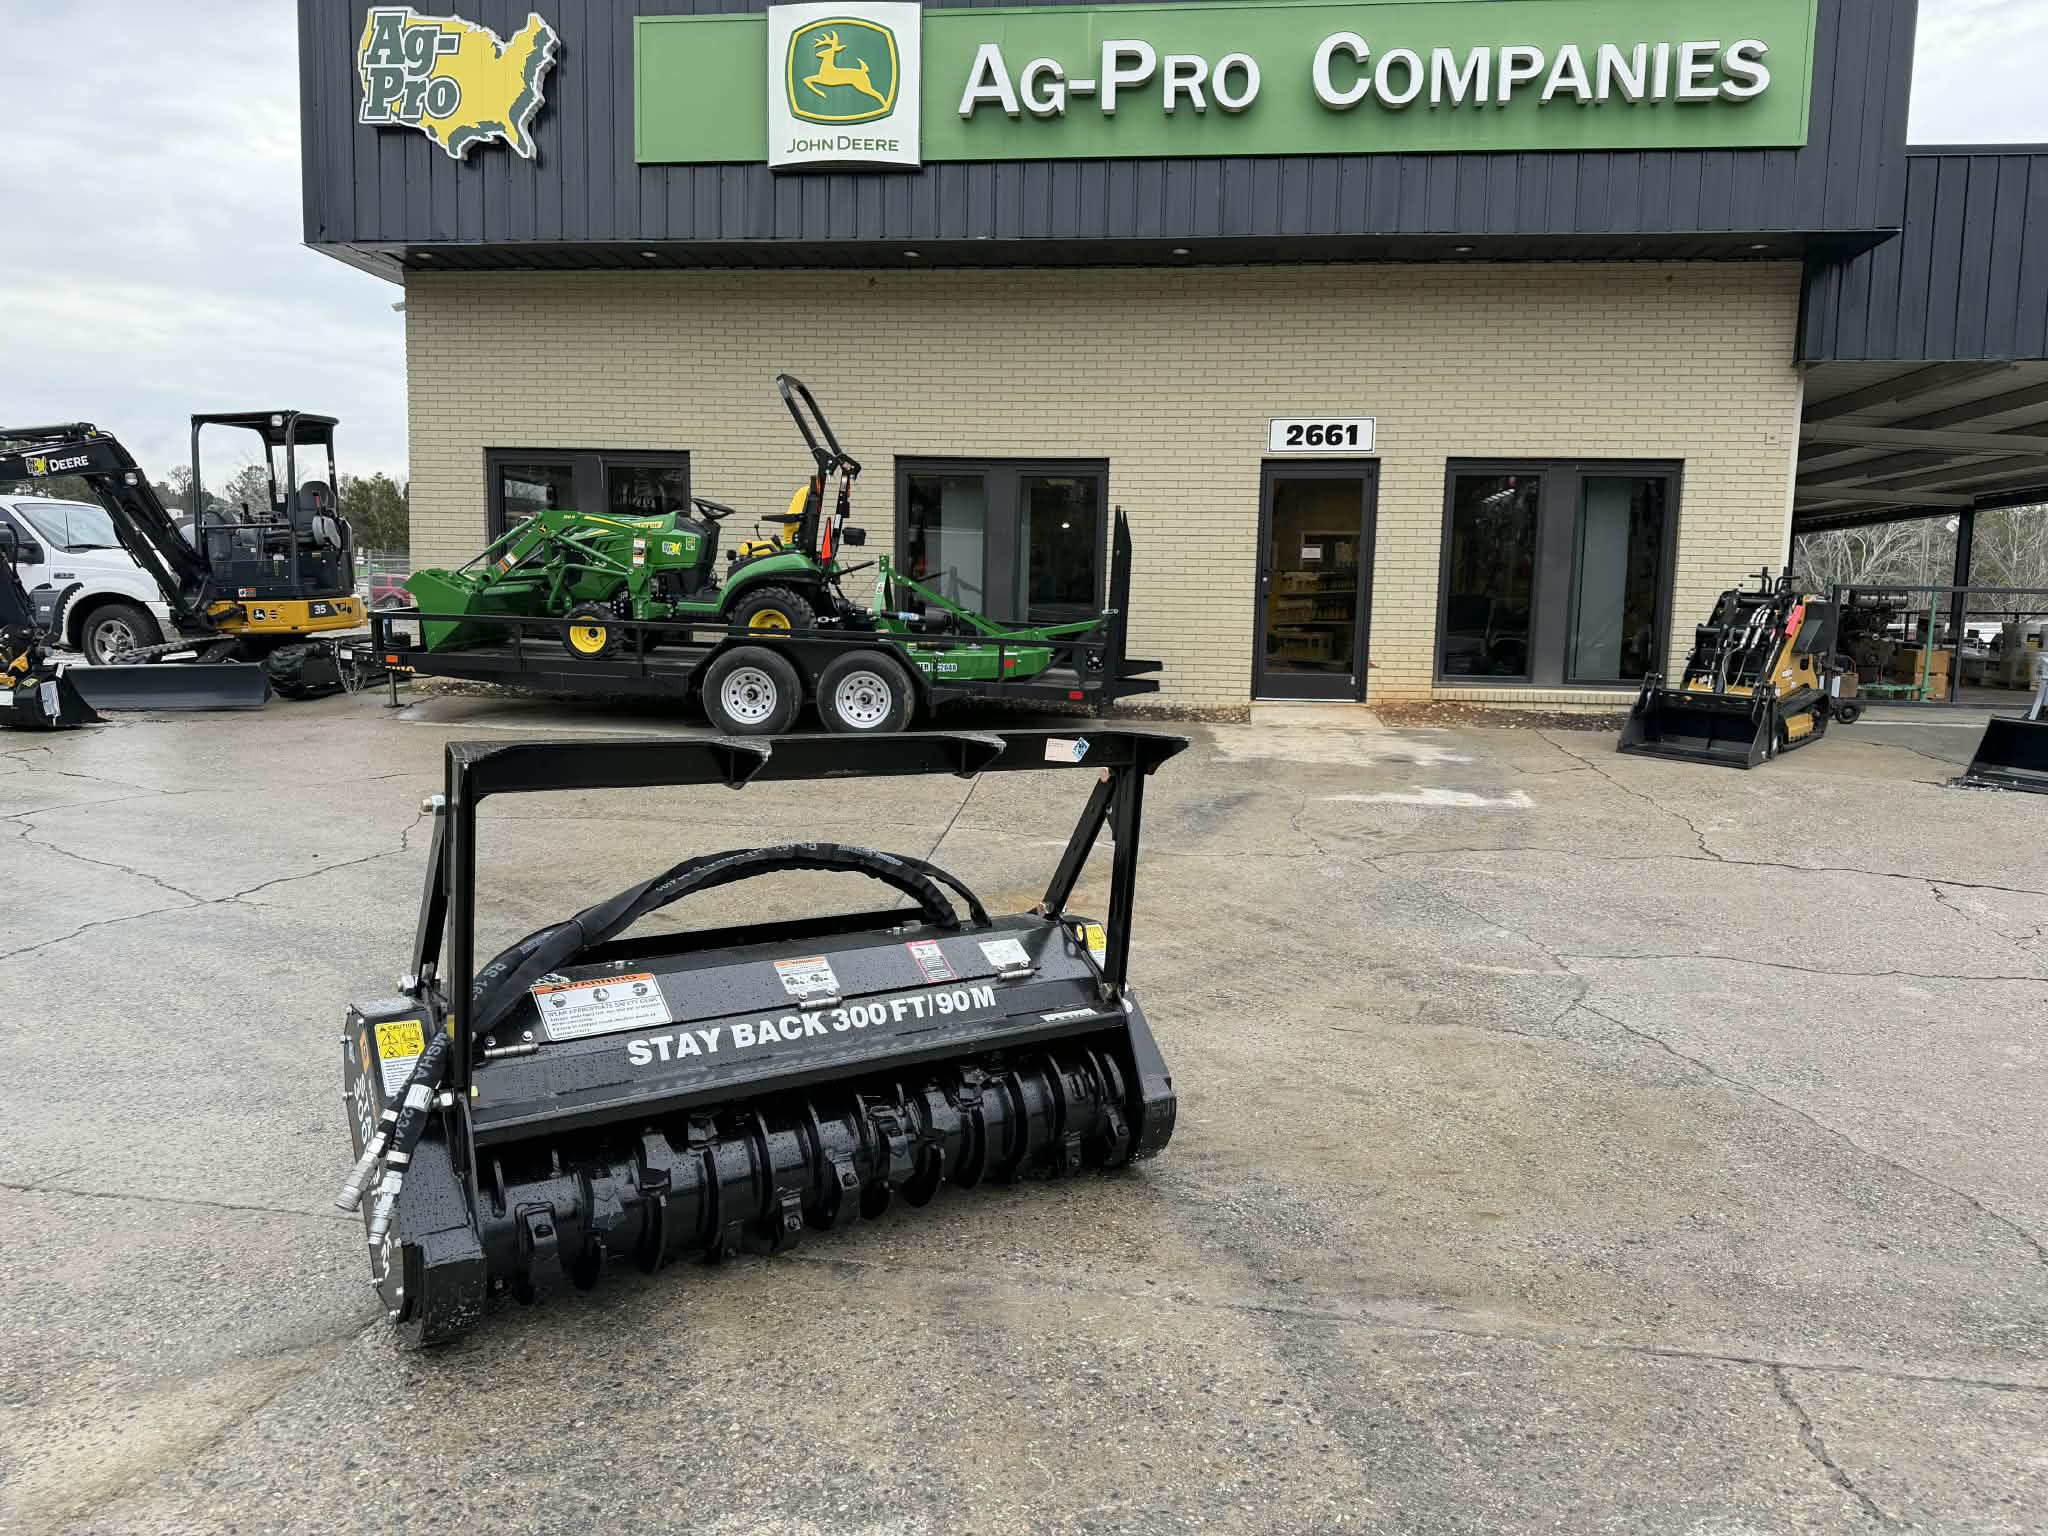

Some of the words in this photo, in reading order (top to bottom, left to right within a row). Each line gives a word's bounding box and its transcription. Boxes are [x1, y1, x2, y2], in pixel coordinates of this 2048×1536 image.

[364, 12, 459, 78] Ag-
[957, 39, 1261, 119] AG-PRO
[1312, 31, 1772, 110] COMPANIES
[362, 66, 461, 120] Pro
[787, 138, 834, 153] JOHN
[837, 136, 899, 152] DEERE
[1286, 424, 1358, 446] 2661
[49, 456, 89, 472] DEERE
[314, 605, 327, 614] 35
[388, 1023, 417, 1031] CAUTION
[627, 1027, 721, 1067] STAY
[730, 1011, 829, 1049] BACK
[830, 1003, 887, 1032] 300
